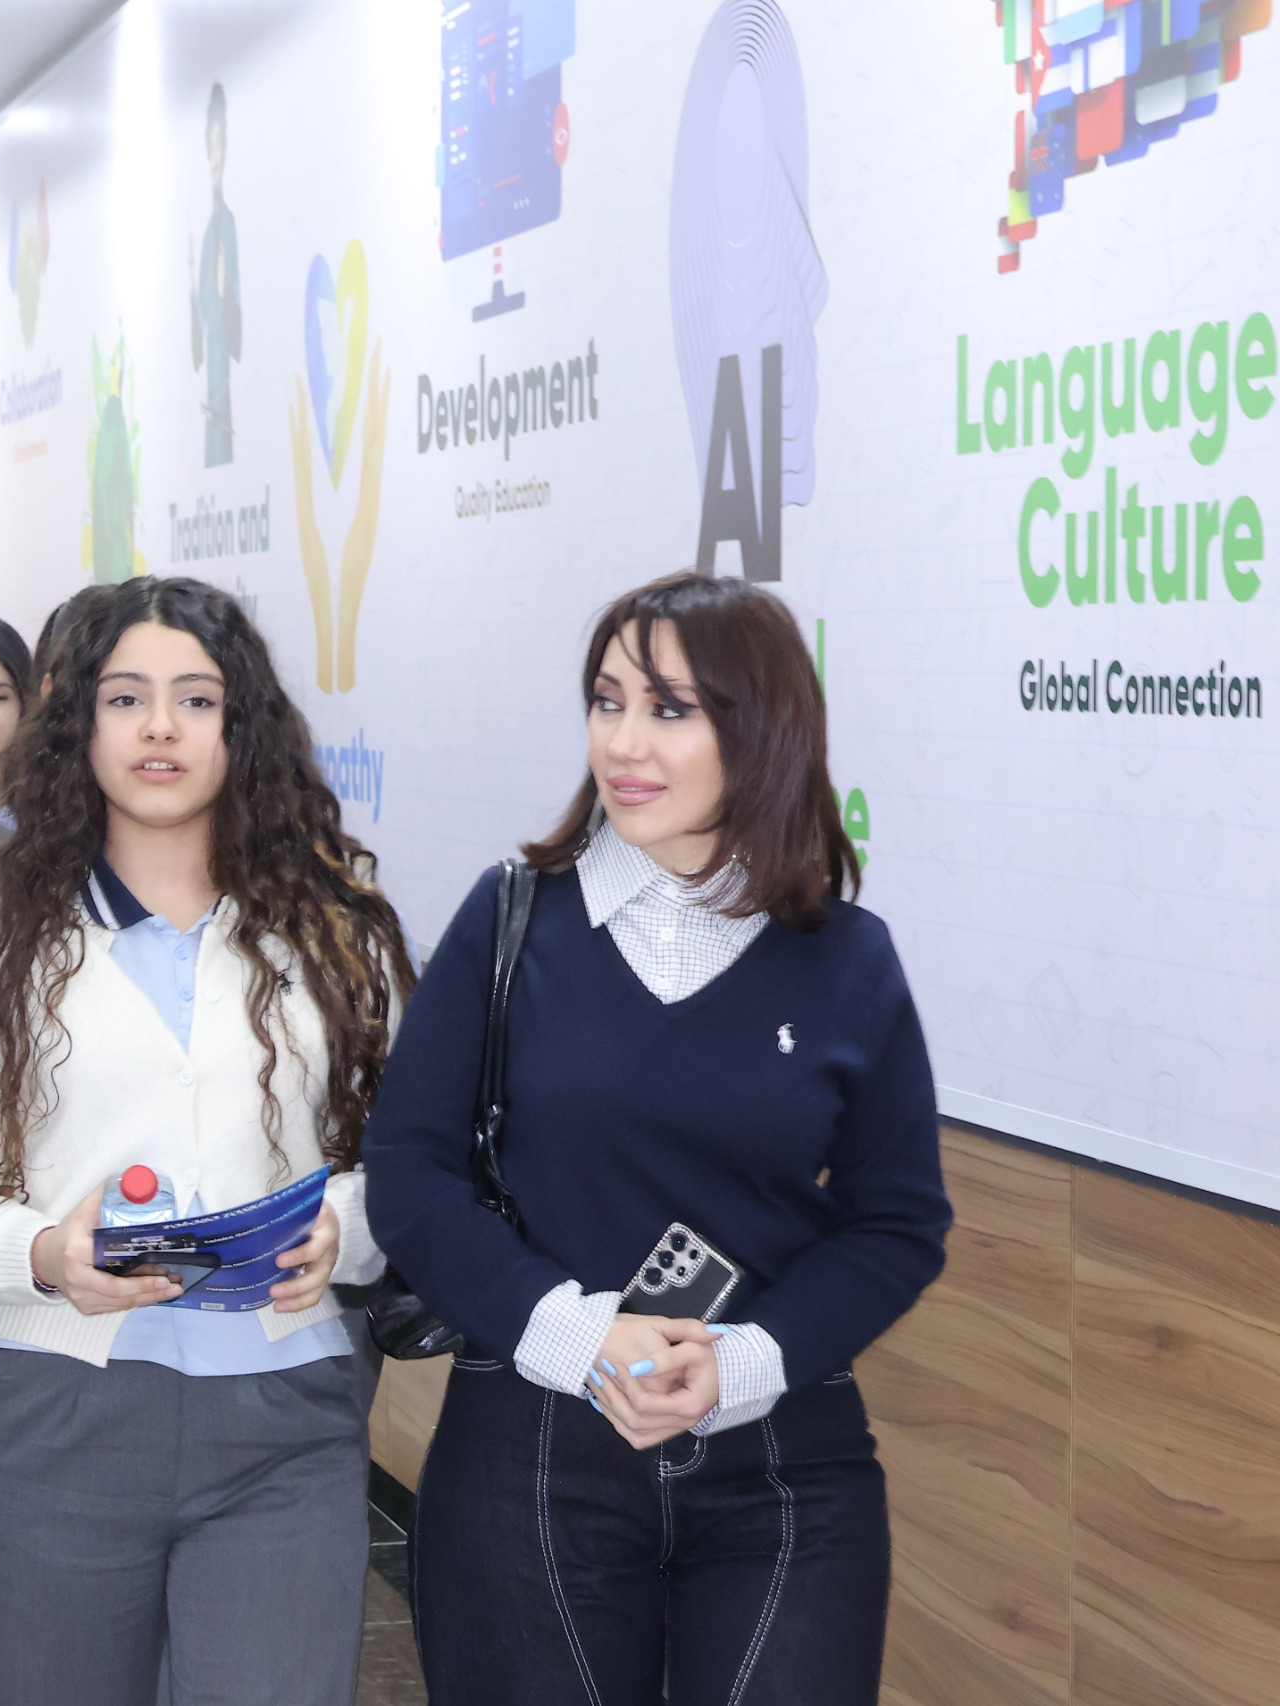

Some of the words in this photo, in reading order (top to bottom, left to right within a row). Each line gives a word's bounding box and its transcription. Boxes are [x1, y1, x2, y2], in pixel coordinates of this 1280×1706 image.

[416, 339, 600, 461] Development
[956, 311, 1278, 480] Language
[454, 482, 492, 523] Quality
[494, 473, 552, 514] Education
[695, 342, 783, 583] AI
[169, 492, 235, 563] Tradition
[238, 483, 270, 556] and
[1017, 465, 1265, 609] Culture
[1019, 658, 1098, 712] Global
[1106, 659, 1263, 719] Connection
[312, 727, 385, 825] pathy
